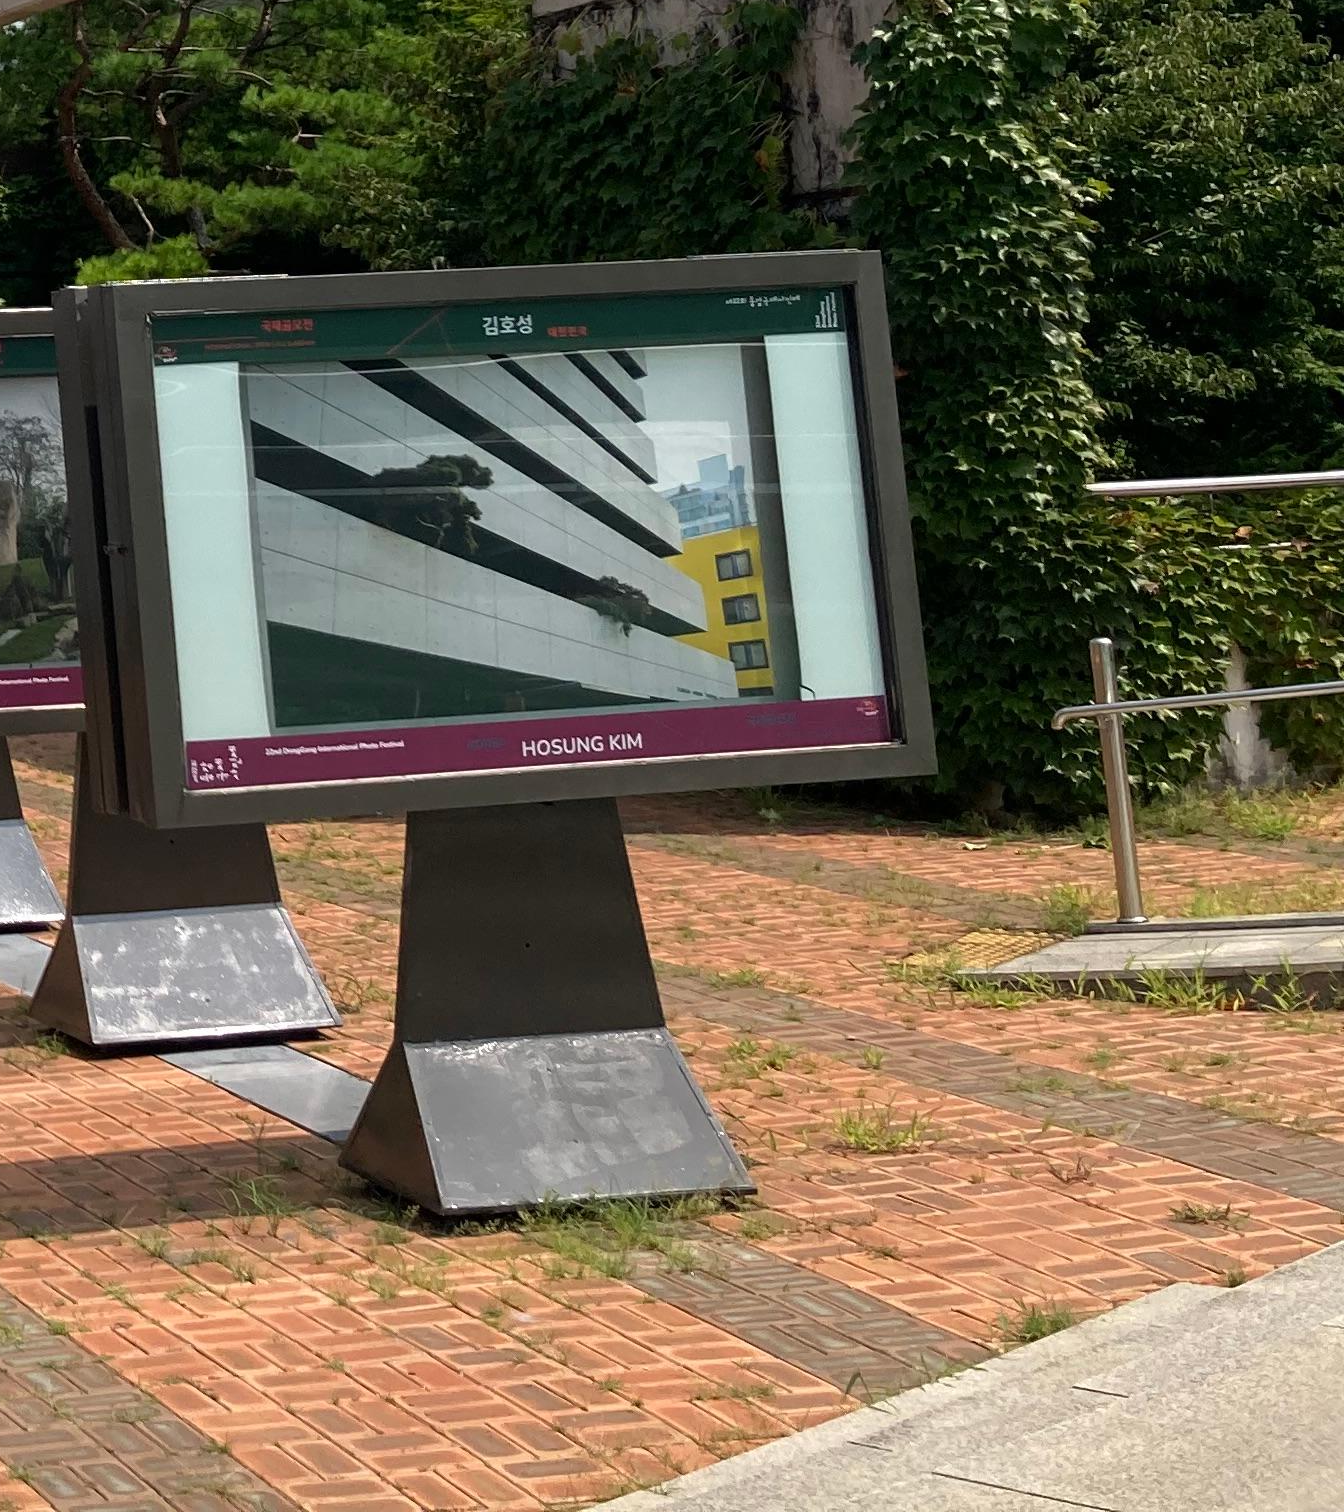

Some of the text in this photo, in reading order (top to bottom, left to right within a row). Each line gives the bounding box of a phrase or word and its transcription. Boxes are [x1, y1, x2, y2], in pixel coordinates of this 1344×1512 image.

[481, 313, 534, 337] 김호성
[521, 735, 604, 758] HOSUNG
[608, 732, 644, 752] KIM
